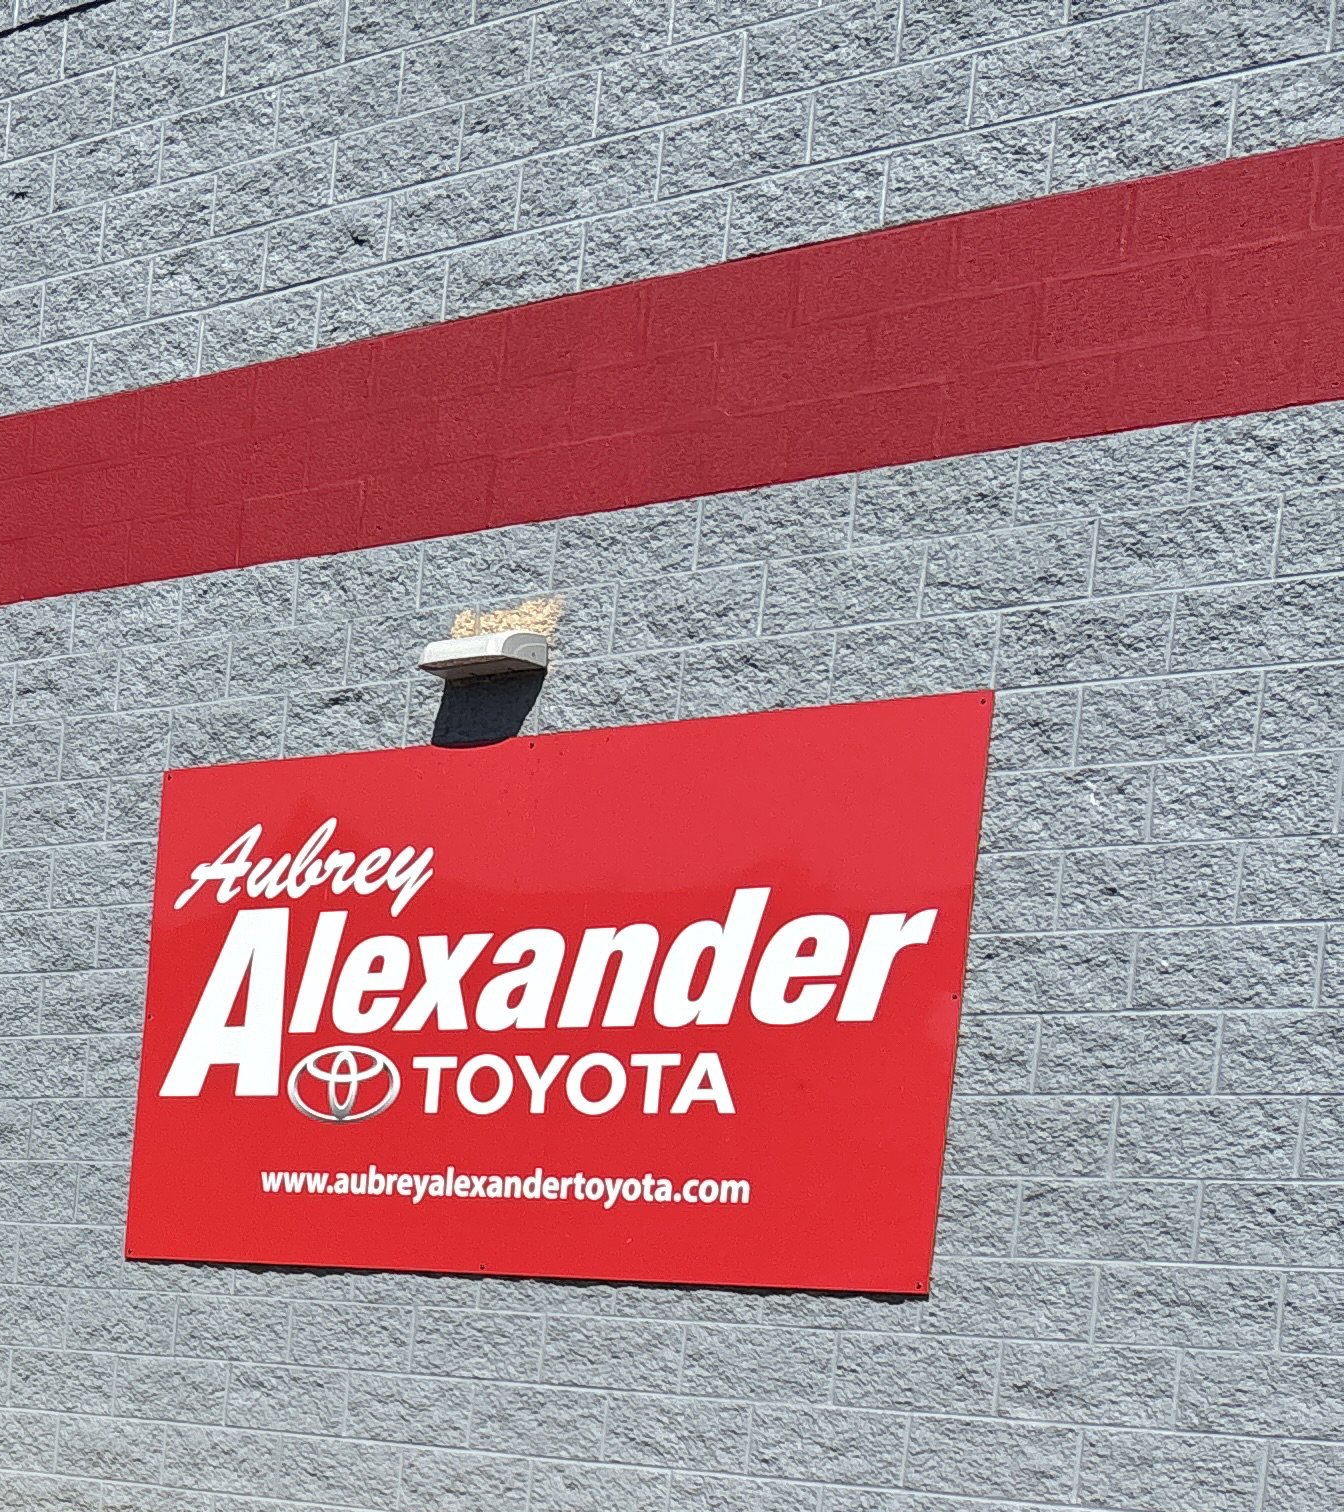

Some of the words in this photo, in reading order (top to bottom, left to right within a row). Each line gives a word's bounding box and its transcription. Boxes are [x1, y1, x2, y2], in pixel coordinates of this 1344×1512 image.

[174, 818, 433, 917] Aubrey
[159, 887, 938, 1096] Alexander
[413, 1053, 735, 1115] TOYOTA
[262, 1165, 750, 1209] www.aubreyalexandertoyota.com
